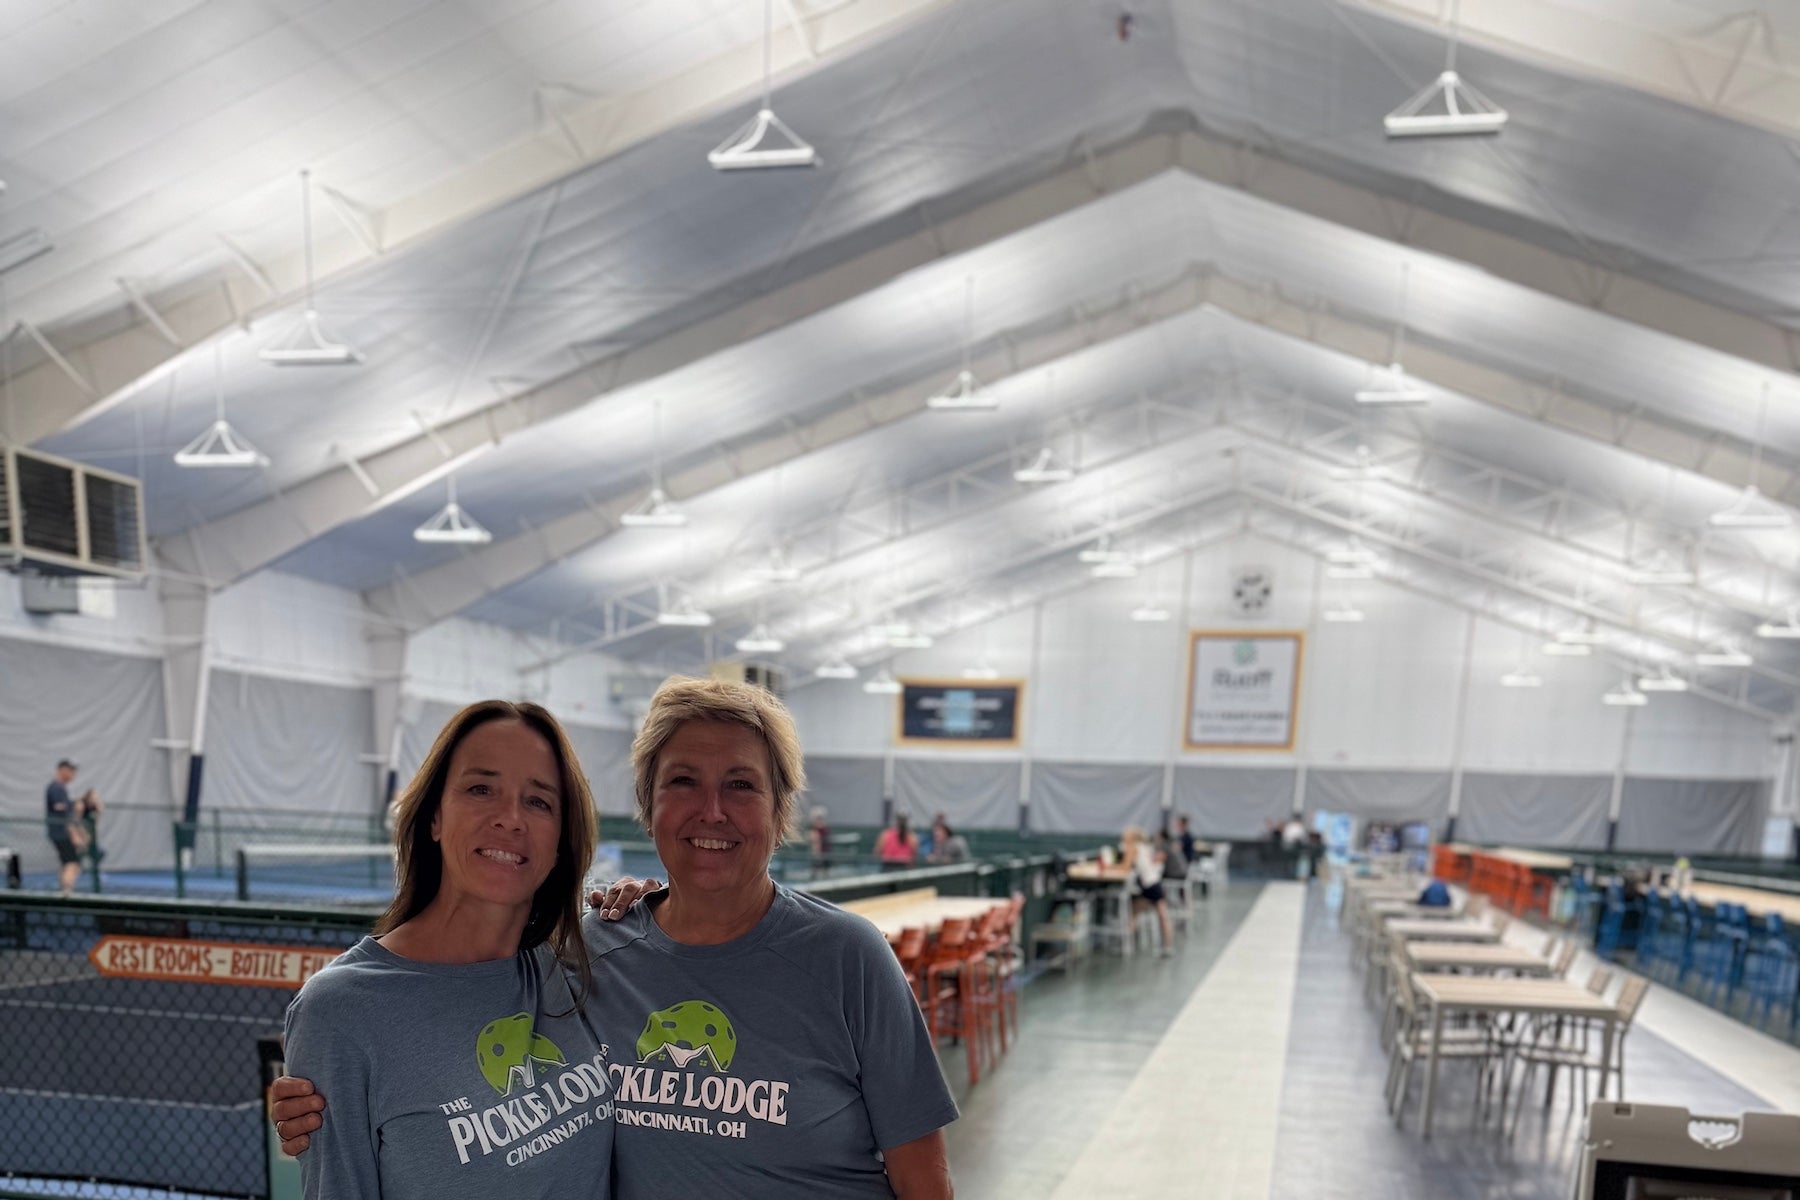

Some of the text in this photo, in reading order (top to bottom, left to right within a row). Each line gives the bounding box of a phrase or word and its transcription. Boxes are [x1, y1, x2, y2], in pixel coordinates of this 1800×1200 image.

[230, 950, 289, 978] BOTTLE
[439, 1096, 472, 1116] THE
[448, 1043, 614, 1165] PICKLE LOD
[609, 1063, 790, 1126] CKLE LODGE
[506, 1099, 615, 1167] CINCINNATI, OH
[615, 1107, 747, 1139] CINCINNATI, OH
